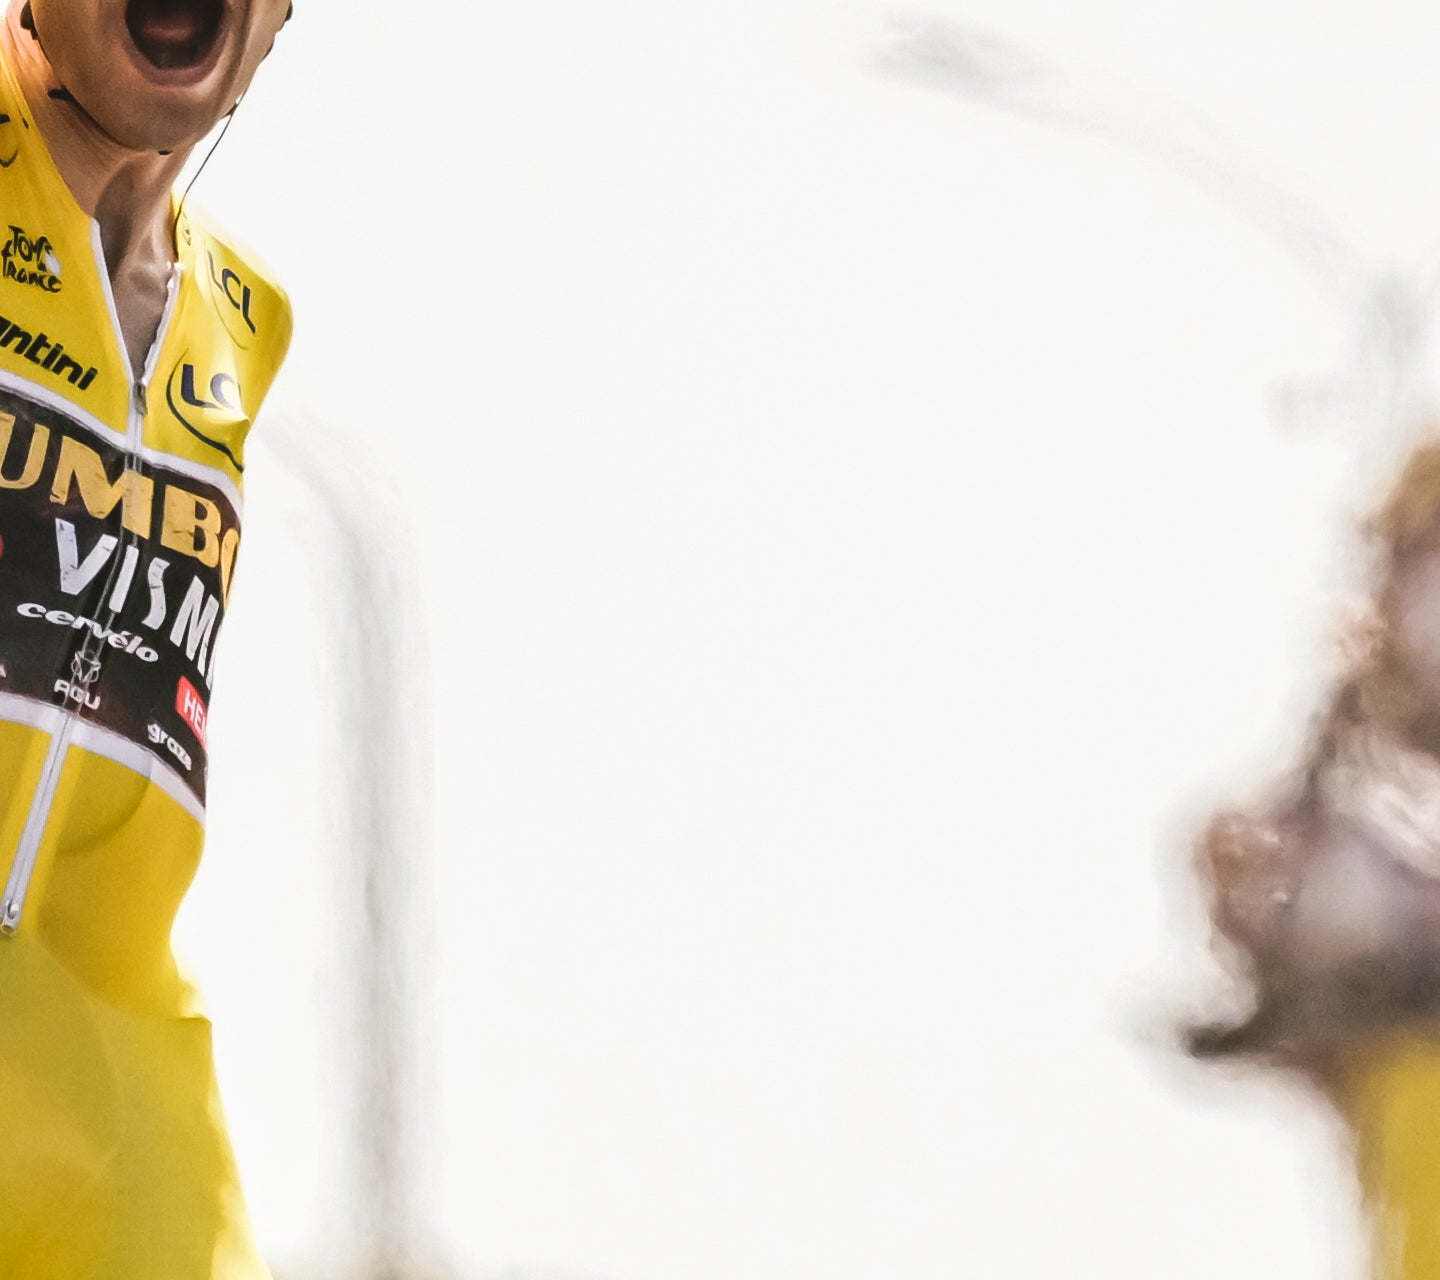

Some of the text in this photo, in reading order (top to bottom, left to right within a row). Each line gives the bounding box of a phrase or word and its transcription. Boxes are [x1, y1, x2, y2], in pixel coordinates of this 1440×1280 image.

[207, 248, 257, 334] LCL
[180, 363, 244, 410] LC
[54, 517, 220, 691] VISM
